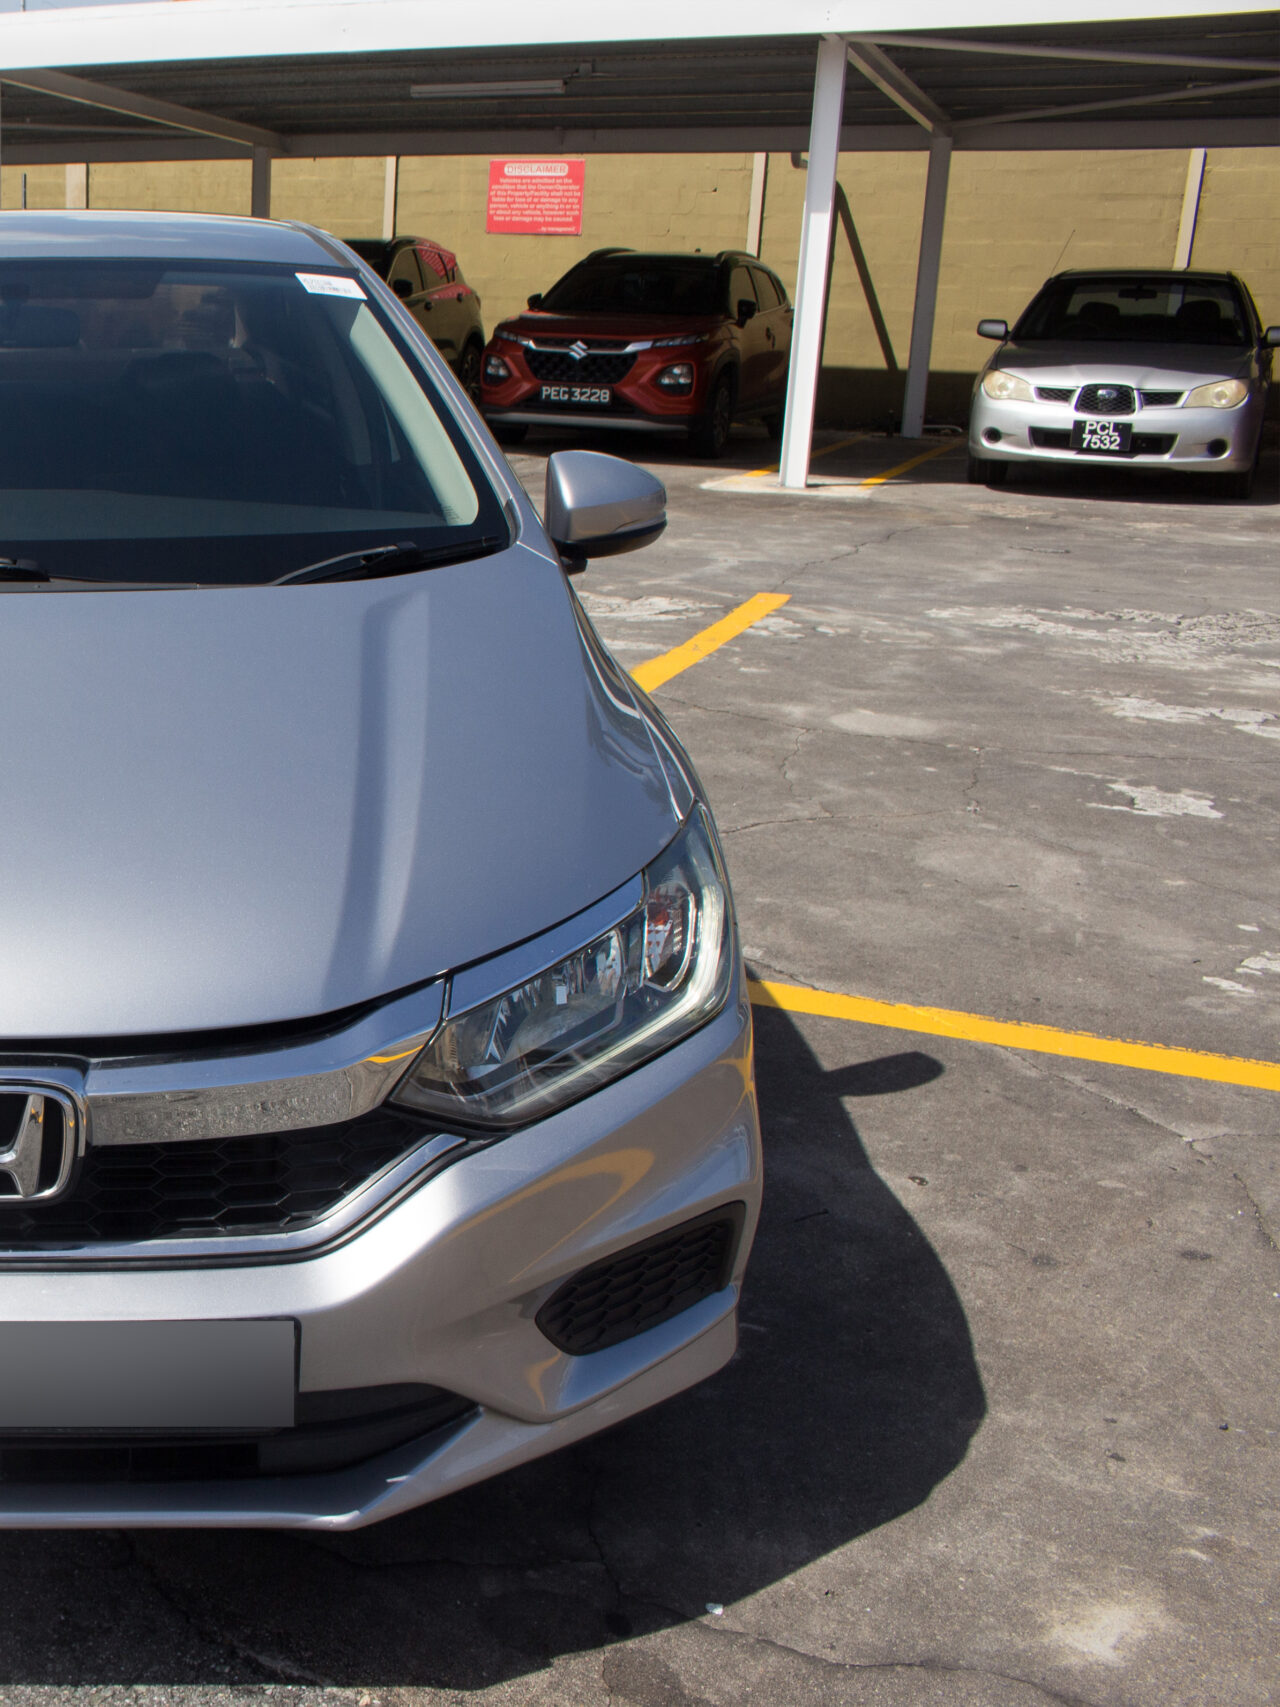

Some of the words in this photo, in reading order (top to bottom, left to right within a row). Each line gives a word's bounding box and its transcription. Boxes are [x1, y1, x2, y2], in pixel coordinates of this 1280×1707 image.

[507, 165, 566, 174] DISCLAIMER
[542, 386, 568, 400] PEG
[571, 387, 610, 402] 3228
[1085, 421, 1119, 436] PCL
[1082, 434, 1121, 450] 7532
